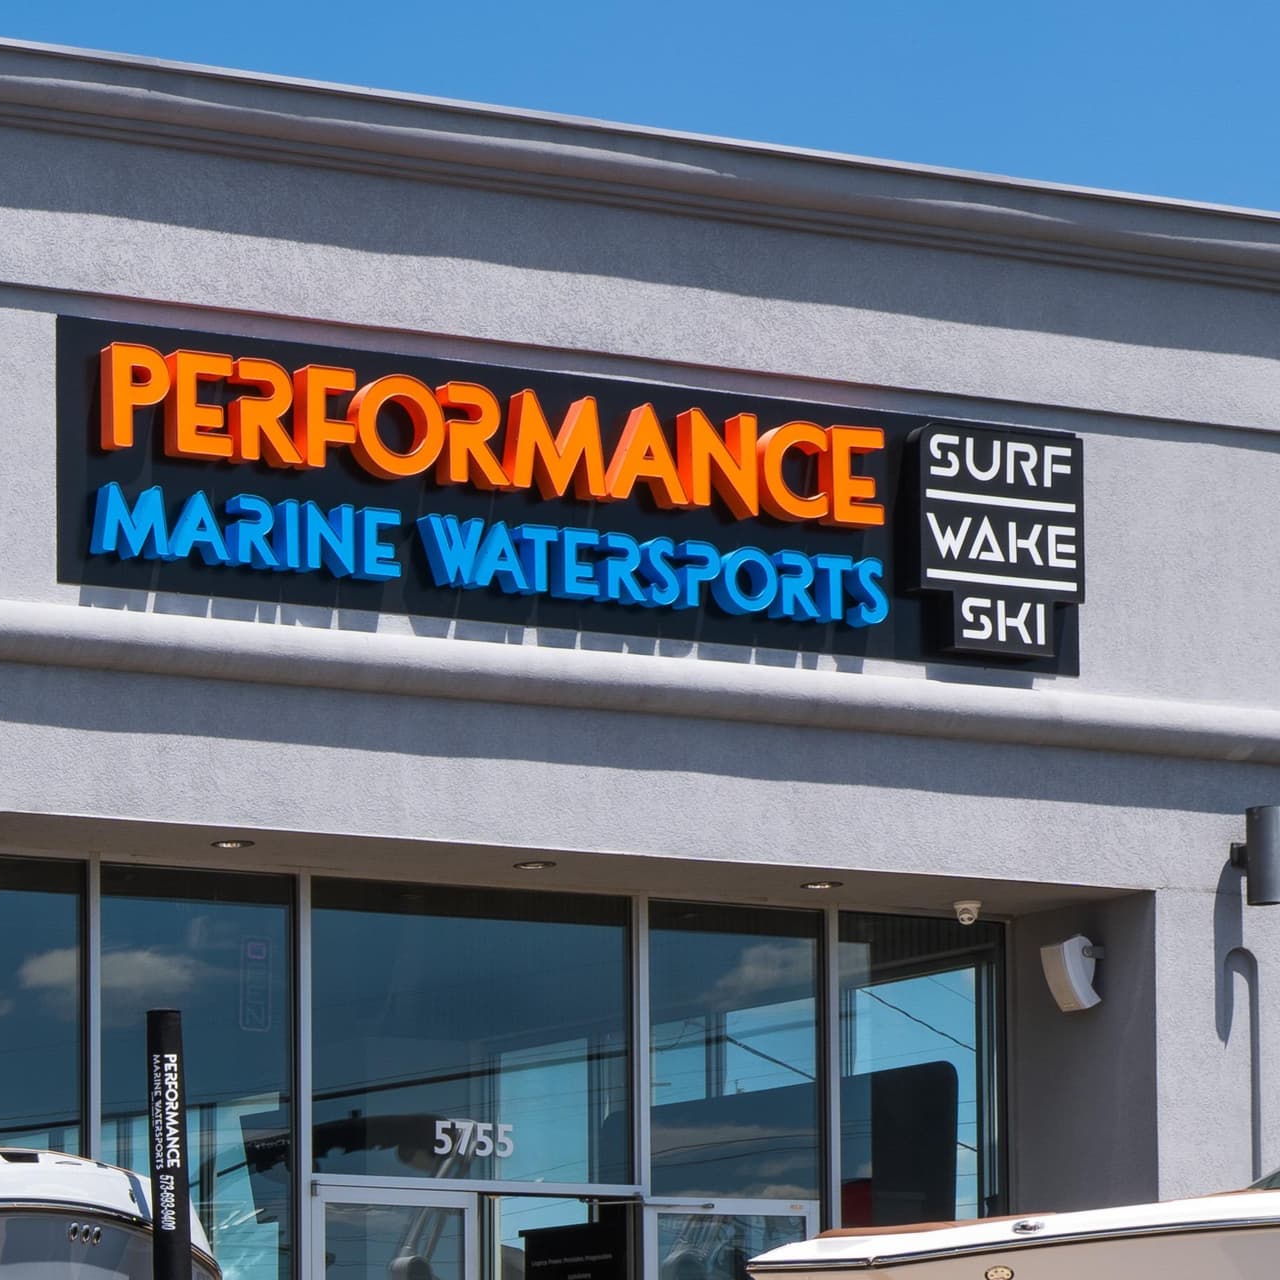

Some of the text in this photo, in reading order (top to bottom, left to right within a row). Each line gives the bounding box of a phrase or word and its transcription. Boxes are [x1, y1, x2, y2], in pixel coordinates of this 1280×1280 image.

[100, 341, 886, 527] PERFORMANCE
[929, 433, 1073, 488] SURF
[89, 480, 889, 628] MARINE WATERSPORTS
[926, 512, 1077, 569] WAKE
[961, 596, 1046, 645] SKI
[152, 1054, 162, 1097] MARINE
[154, 1099, 164, 1170] WATERSPORTS
[163, 1053, 180, 1169] PERFORMANCE
[433, 1120, 514, 1158] 5755
[159, 1174, 176, 1231] 573-693-9400
